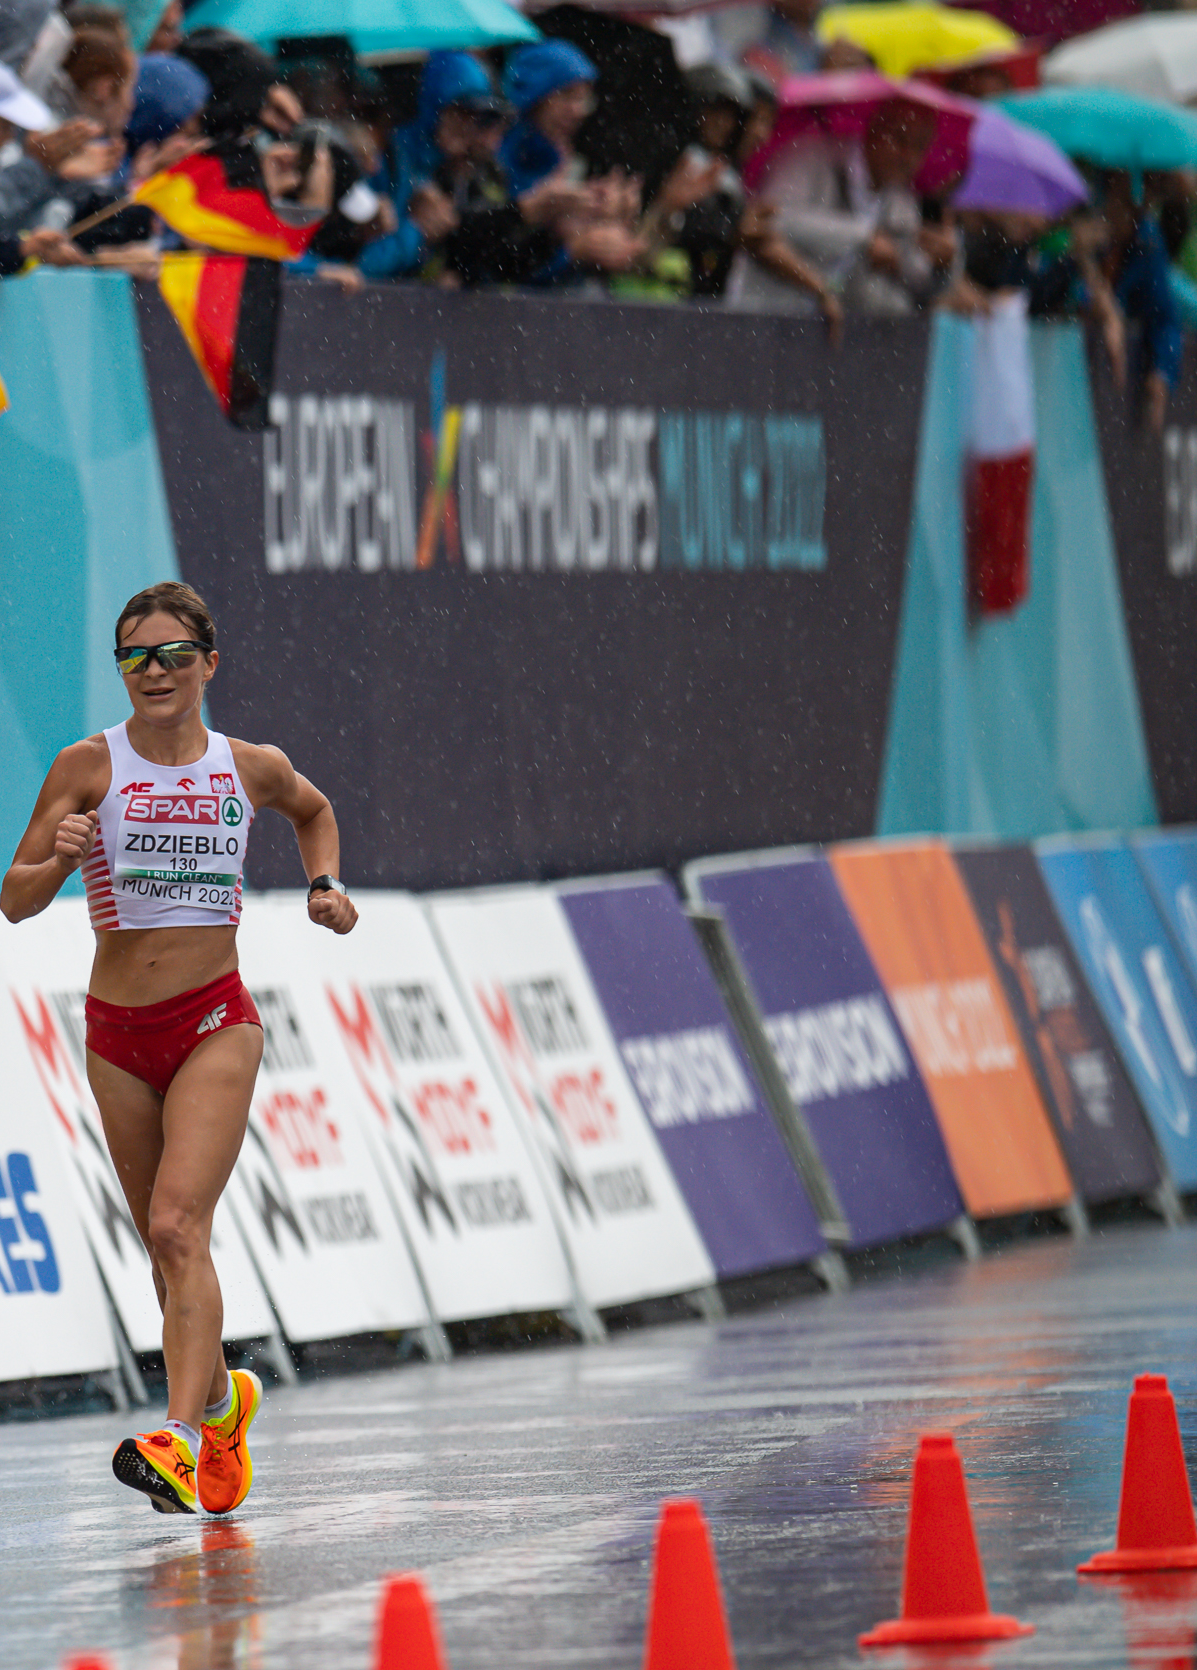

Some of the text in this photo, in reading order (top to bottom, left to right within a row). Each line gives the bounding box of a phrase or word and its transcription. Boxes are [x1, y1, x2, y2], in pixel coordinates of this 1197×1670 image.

[128, 798, 217, 821] SPAR
[124, 833, 239, 856] ZDZIEBLO
[169, 857, 198, 871] 130
[154, 871, 179, 881] RUN
[122, 879, 192, 901] MUNICH
